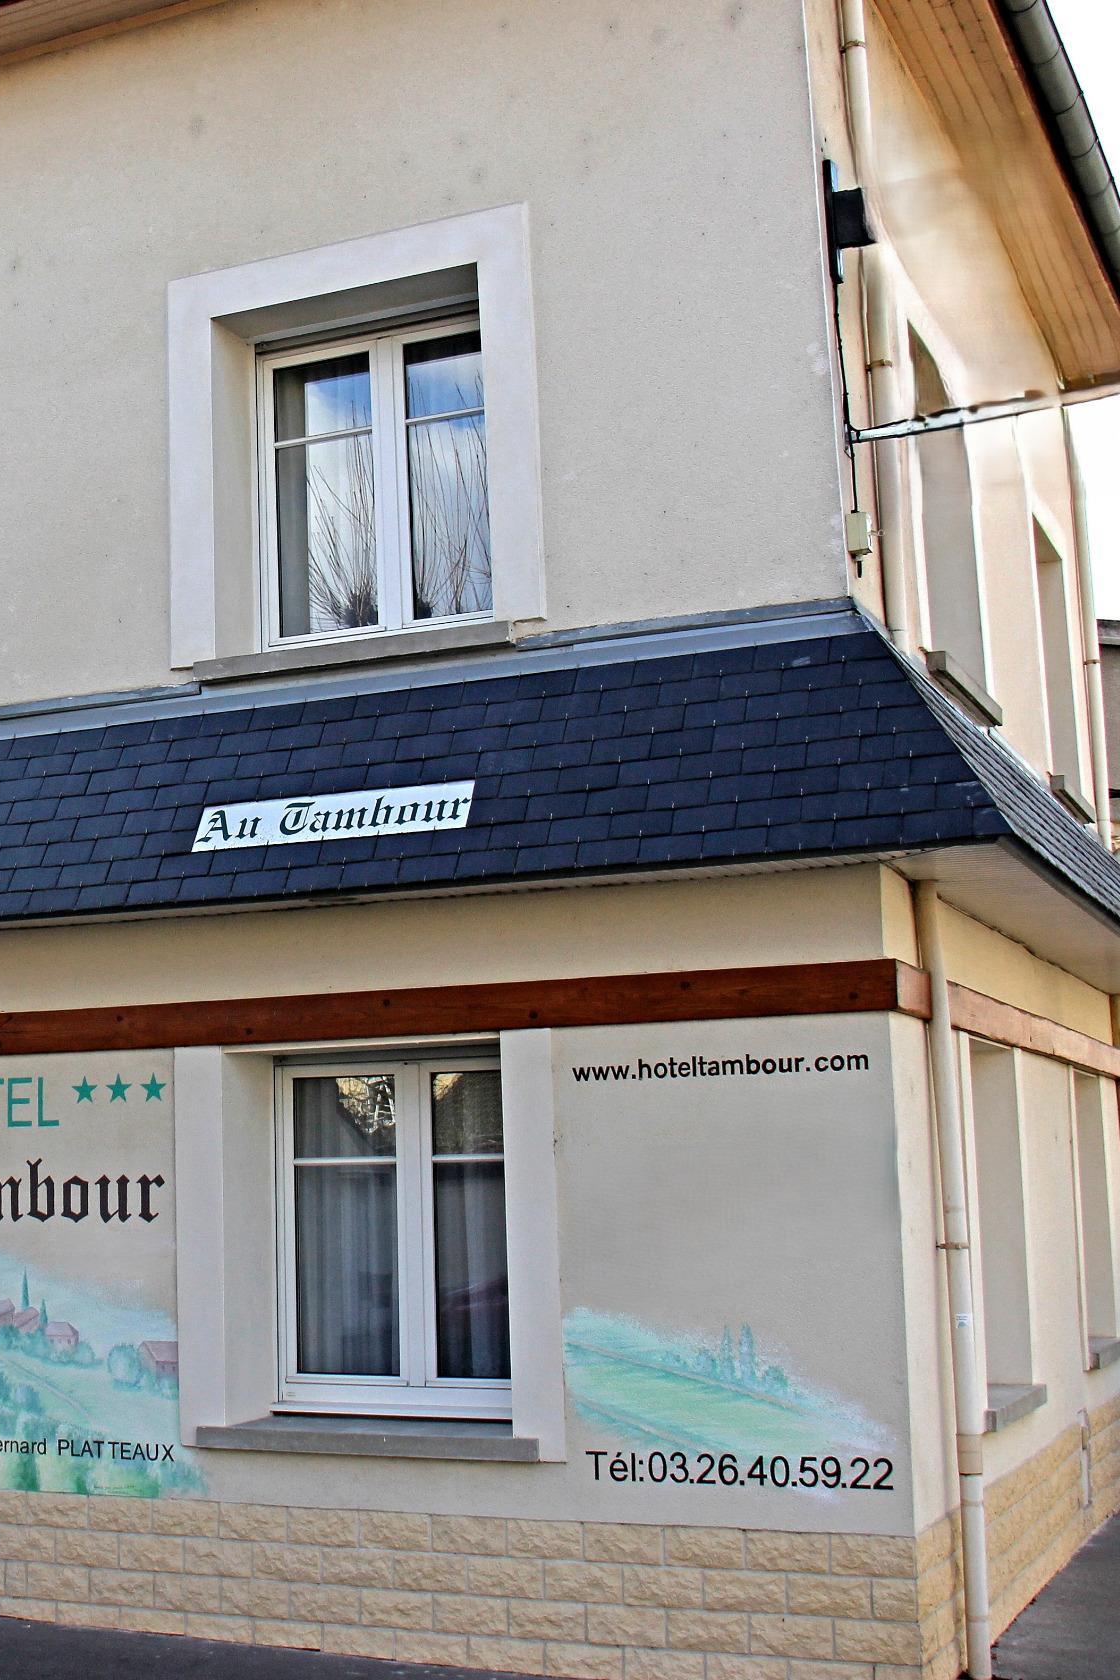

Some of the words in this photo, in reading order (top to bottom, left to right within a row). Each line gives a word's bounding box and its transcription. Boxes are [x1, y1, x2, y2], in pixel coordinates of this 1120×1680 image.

[196, 809, 262, 843] Au
[280, 796, 471, 836] Tambour
[571, 1053, 869, 1082] www.hoteltambour.com
[585, 1450, 894, 1491] Tél:03.26.40.59.22
